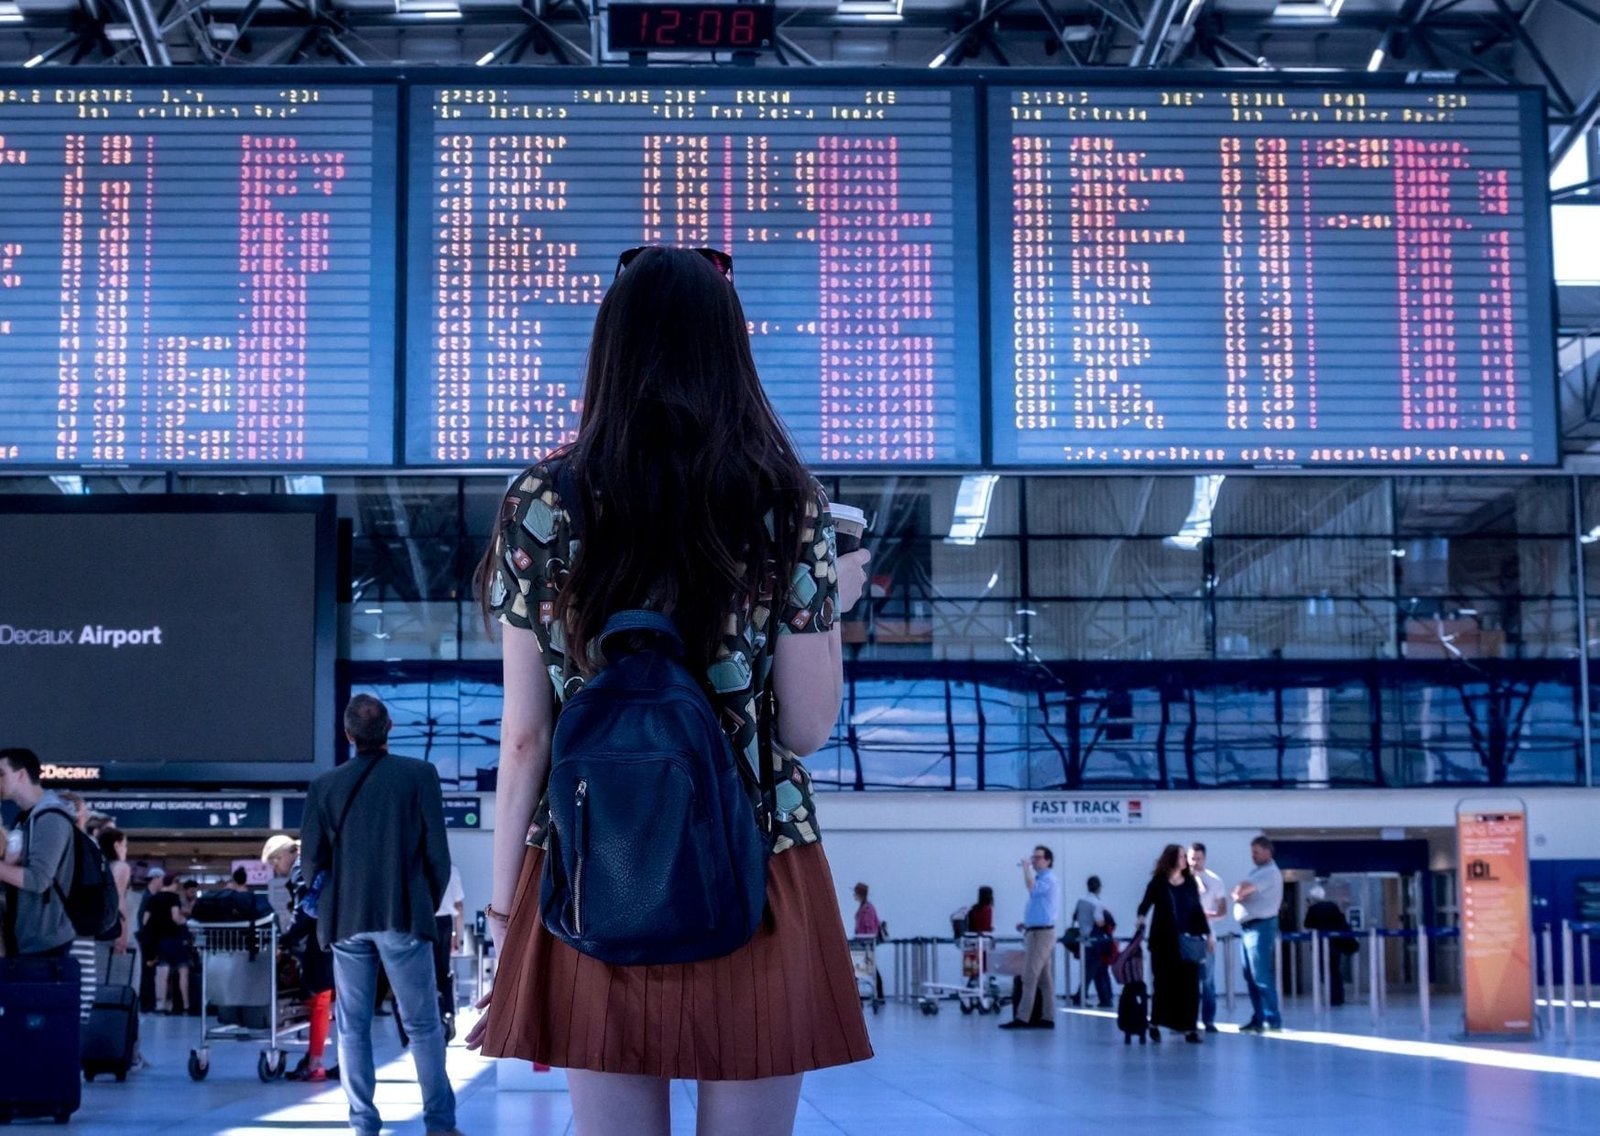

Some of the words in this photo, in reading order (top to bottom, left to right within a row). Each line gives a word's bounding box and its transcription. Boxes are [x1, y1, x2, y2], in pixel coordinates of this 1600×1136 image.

[641, 10, 755, 44] 12:08
[78, 625, 162, 648] Airport
[94, 801, 113, 810] YOUR
[114, 801, 150, 810] PASSPORT
[151, 801, 167, 810] AND
[167, 801, 204, 810] BOARDING
[204, 801, 222, 810] PASS
[223, 801, 248, 810] READY
[1032, 800, 1068, 814] FAST
[1072, 800, 1121, 814] TRACK
